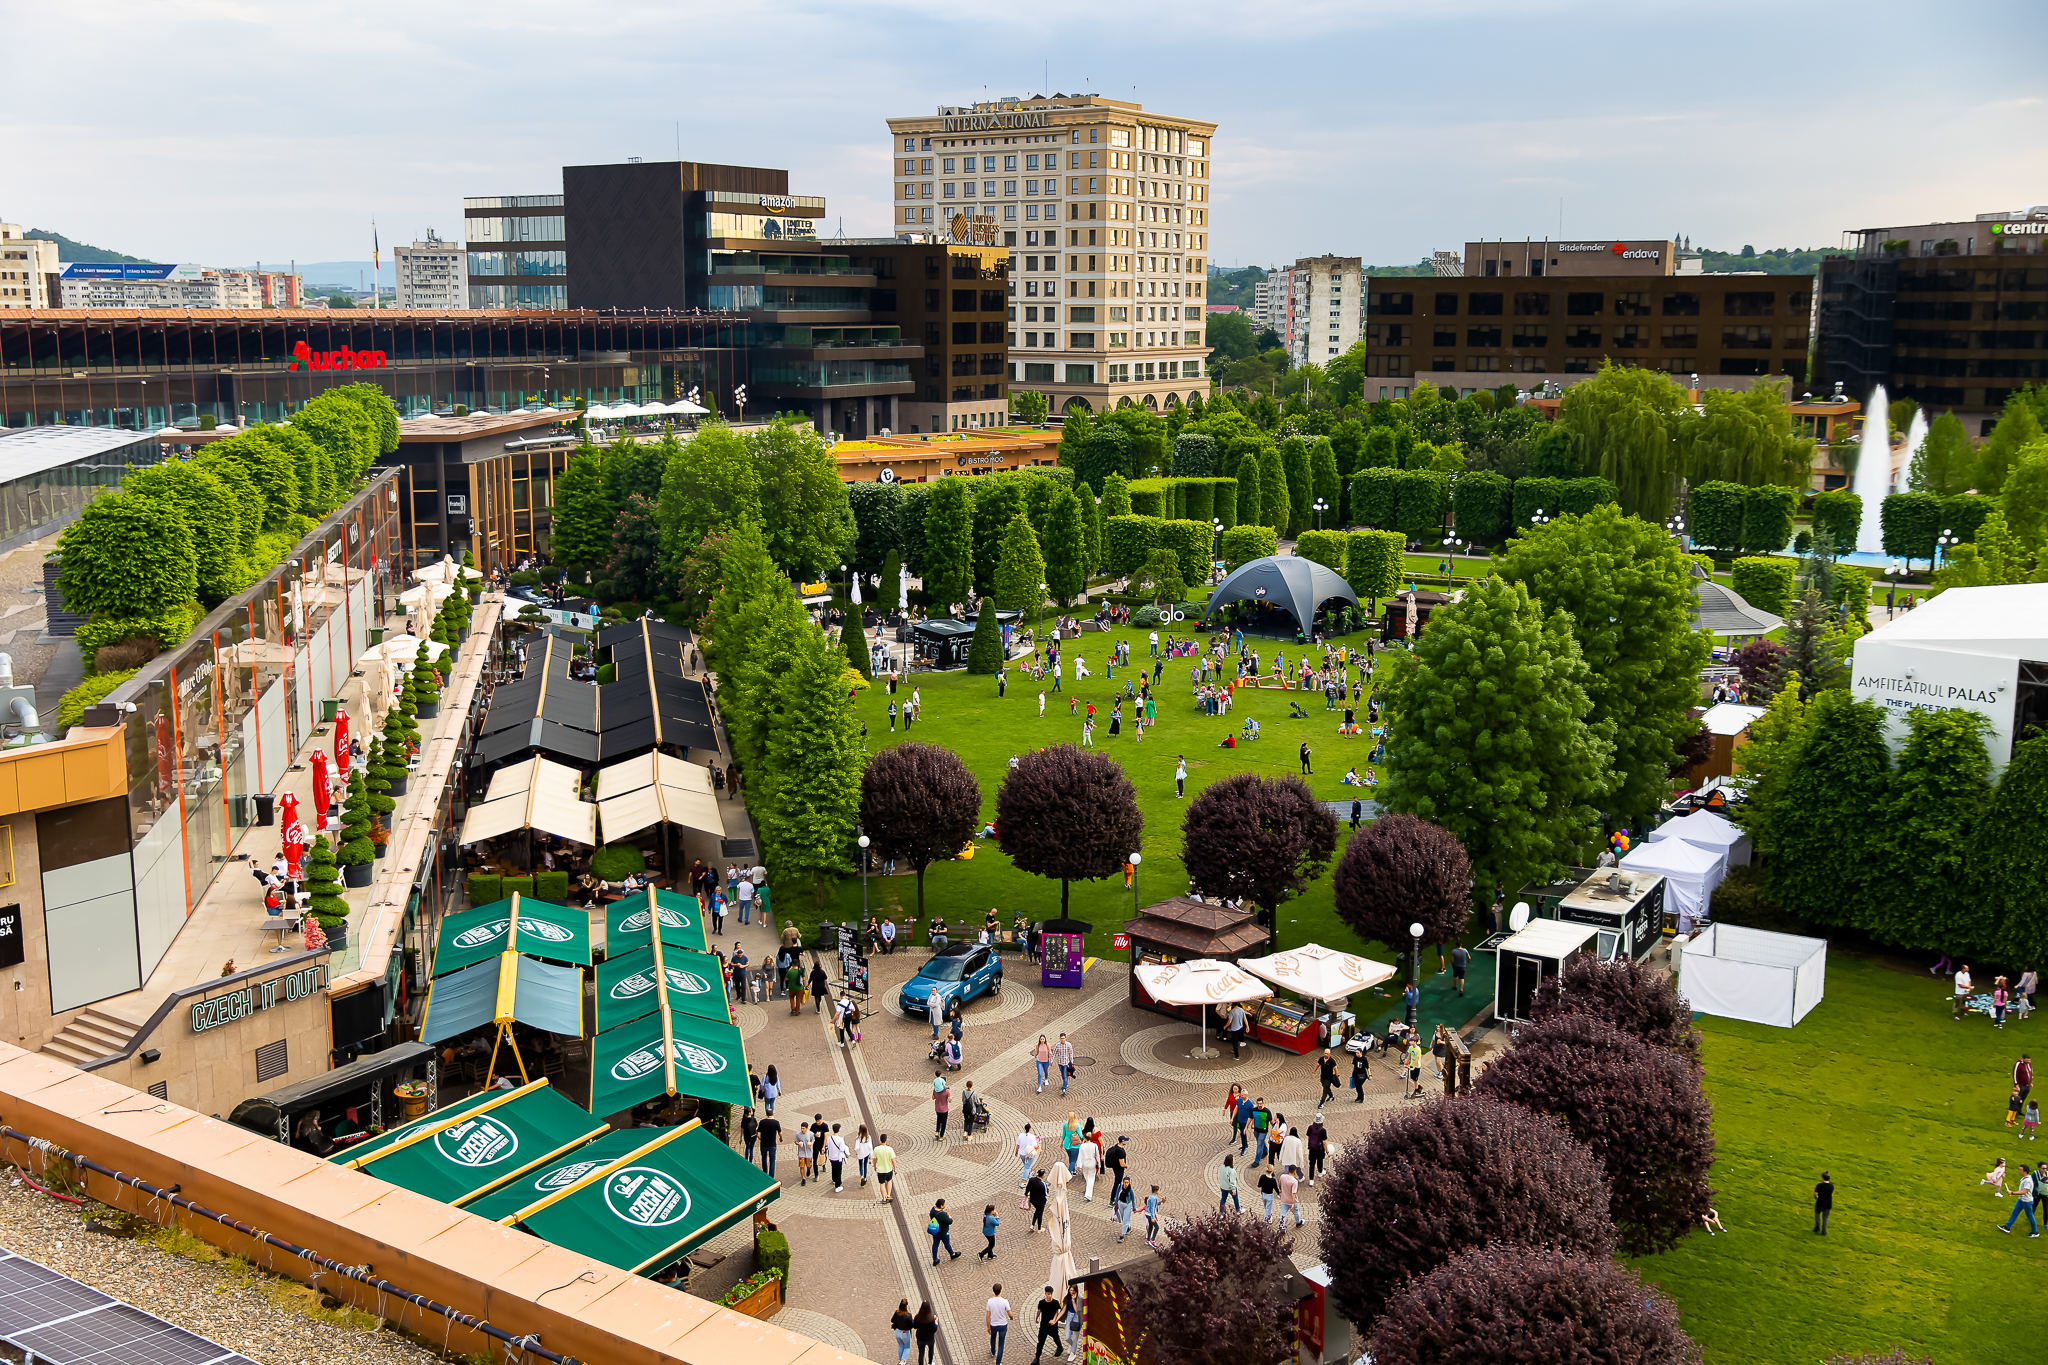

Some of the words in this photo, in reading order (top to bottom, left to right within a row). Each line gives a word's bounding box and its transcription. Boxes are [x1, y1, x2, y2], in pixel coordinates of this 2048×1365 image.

[943, 111, 1049, 132] INTERNATIONAL
[761, 196, 796, 209] amazon
[1559, 243, 1606, 252] Bitdefender
[1622, 249, 1660, 259] endava
[288, 340, 387, 371] Auchan
[968, 456, 989, 465] BISTRO
[1255, 585, 1266, 597] glo
[1159, 603, 1185, 626] glo
[180, 676, 196, 698] Marc
[1857, 676, 1944, 698] AMFITEATRUL
[1948, 686, 1997, 704] PALAS
[1885, 698, 1904, 707] THE
[1904, 701, 1934, 712] PLACE
[1114, 937, 1128, 949] illy
[191, 988, 254, 1032] CZECH
[260, 981, 278, 1011] IT
[285, 966, 320, 1002] OUT
[457, 1129, 493, 1163] CZECH
[480, 1121, 502, 1140] IN
[628, 1185, 665, 1222] CZECH
[649, 1175, 672, 1196] IN
